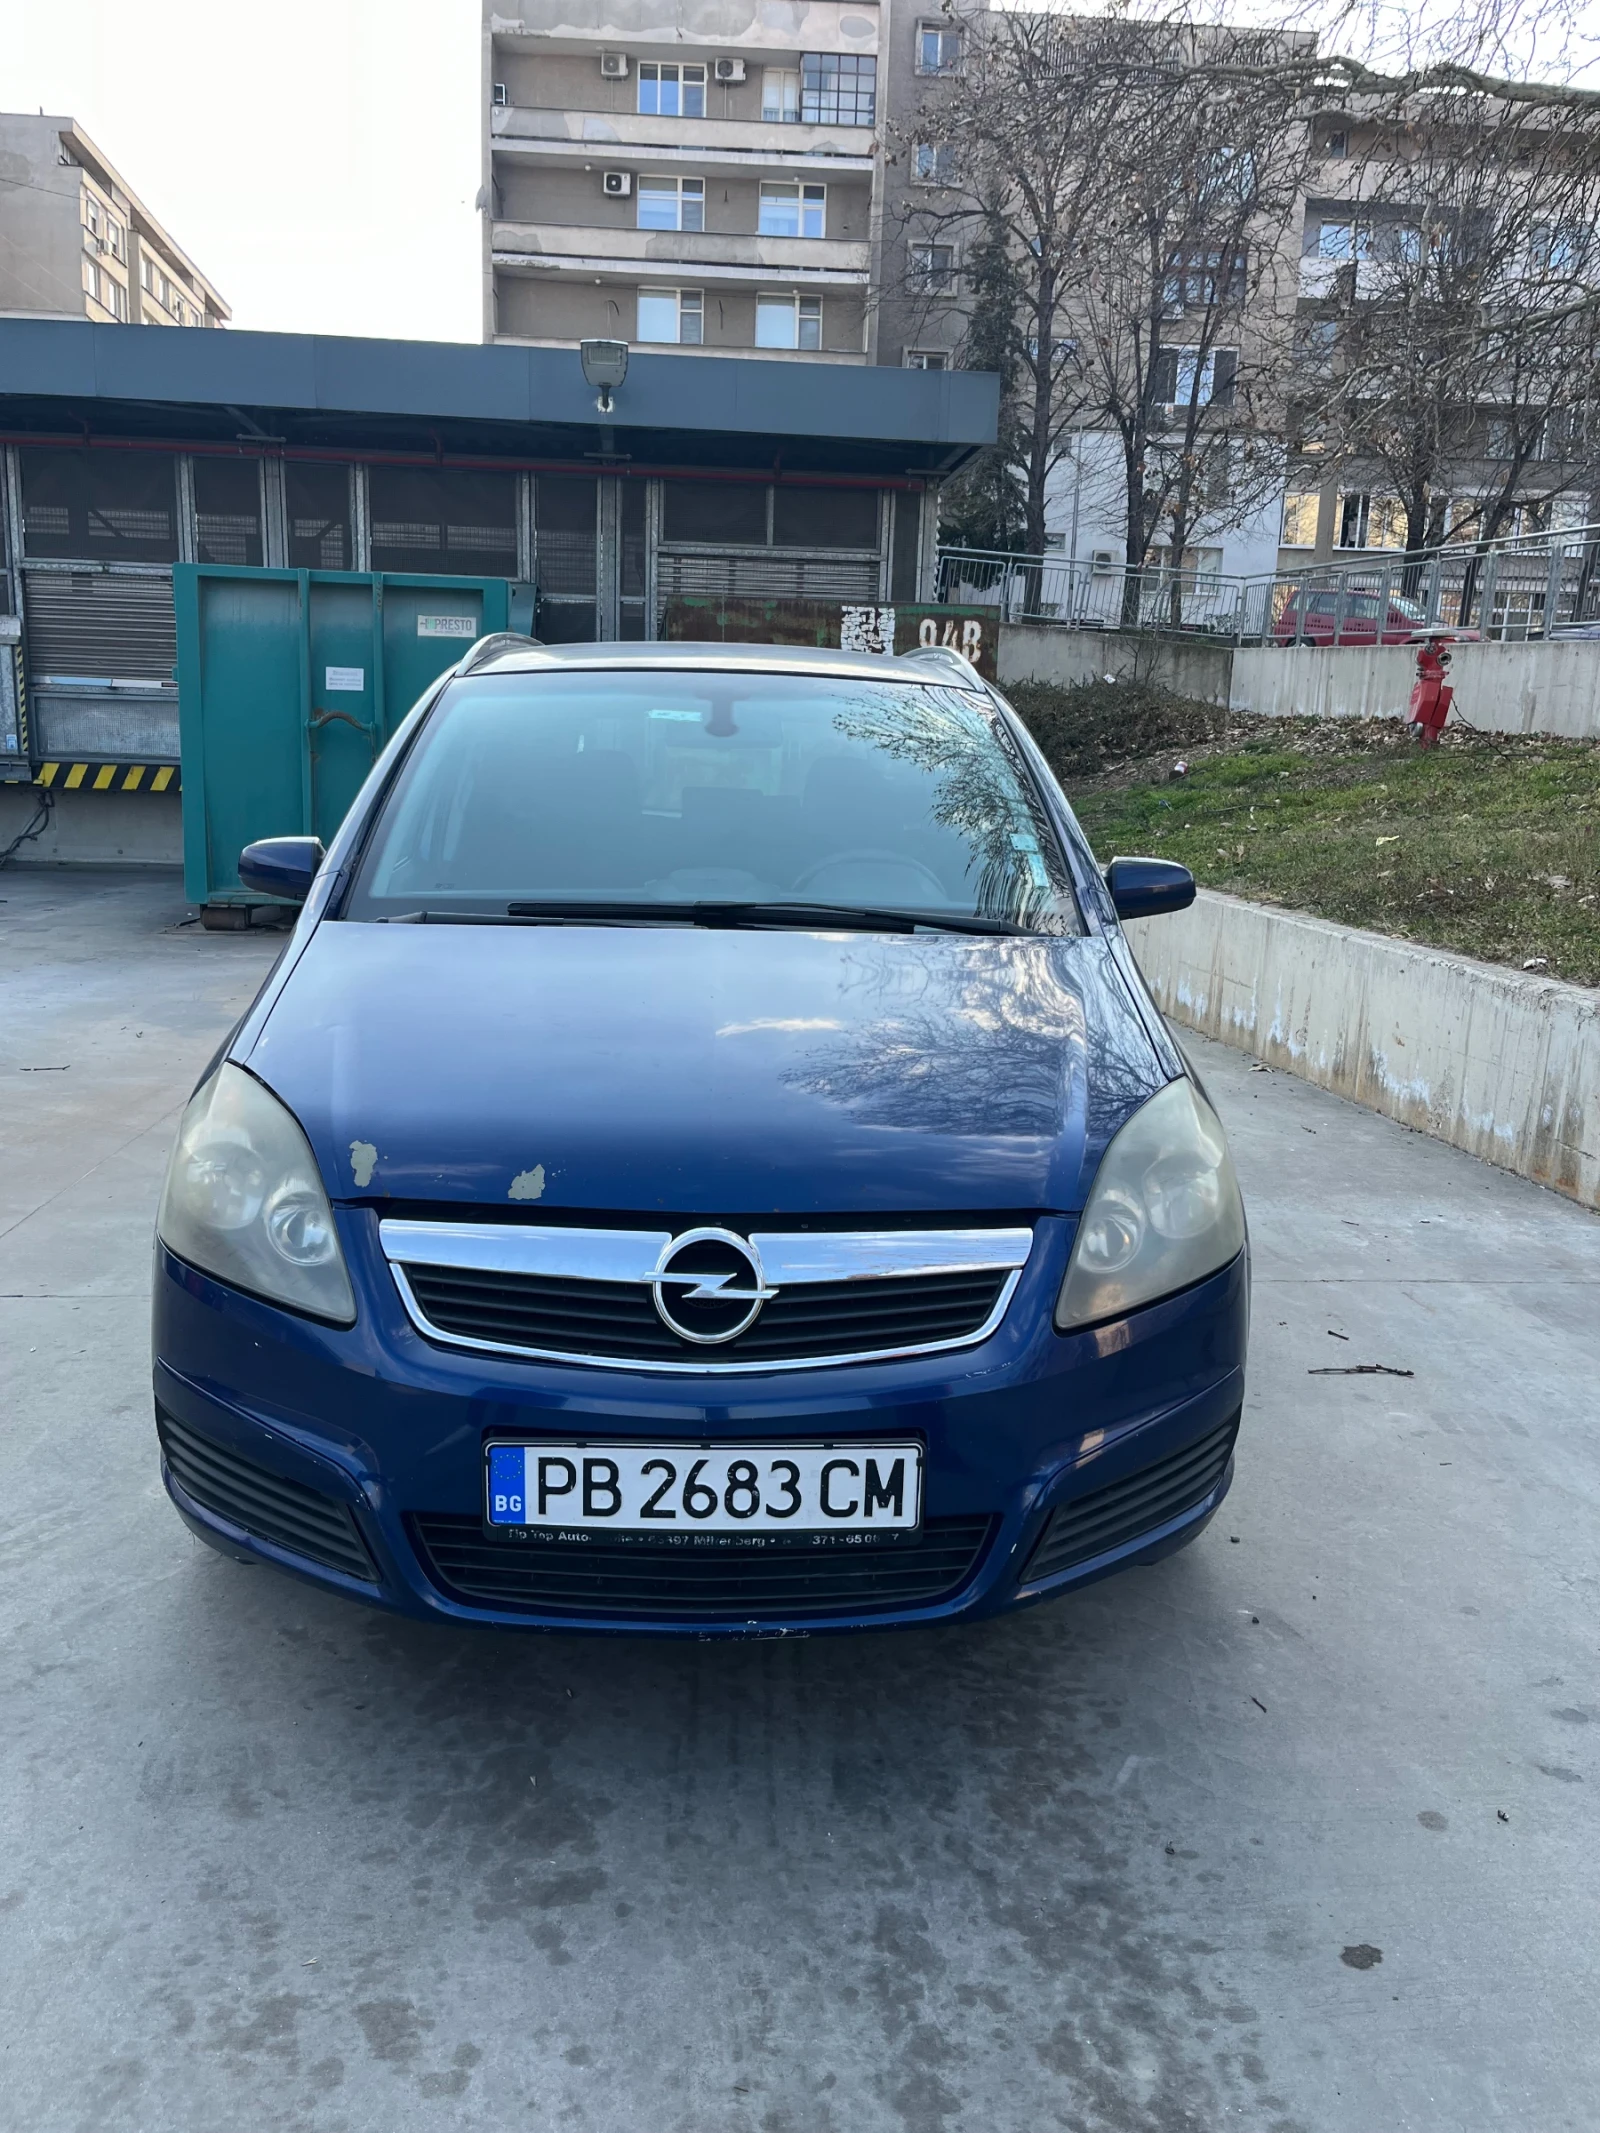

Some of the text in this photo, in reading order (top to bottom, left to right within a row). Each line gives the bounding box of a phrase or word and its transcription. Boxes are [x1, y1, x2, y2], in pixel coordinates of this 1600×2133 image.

[434, 618, 472, 631] PRESTO
[538, 1456, 905, 1519] PB 2683 CM
[495, 1494, 522, 1512] BG
[694, 1535, 765, 1547] Mileberg
